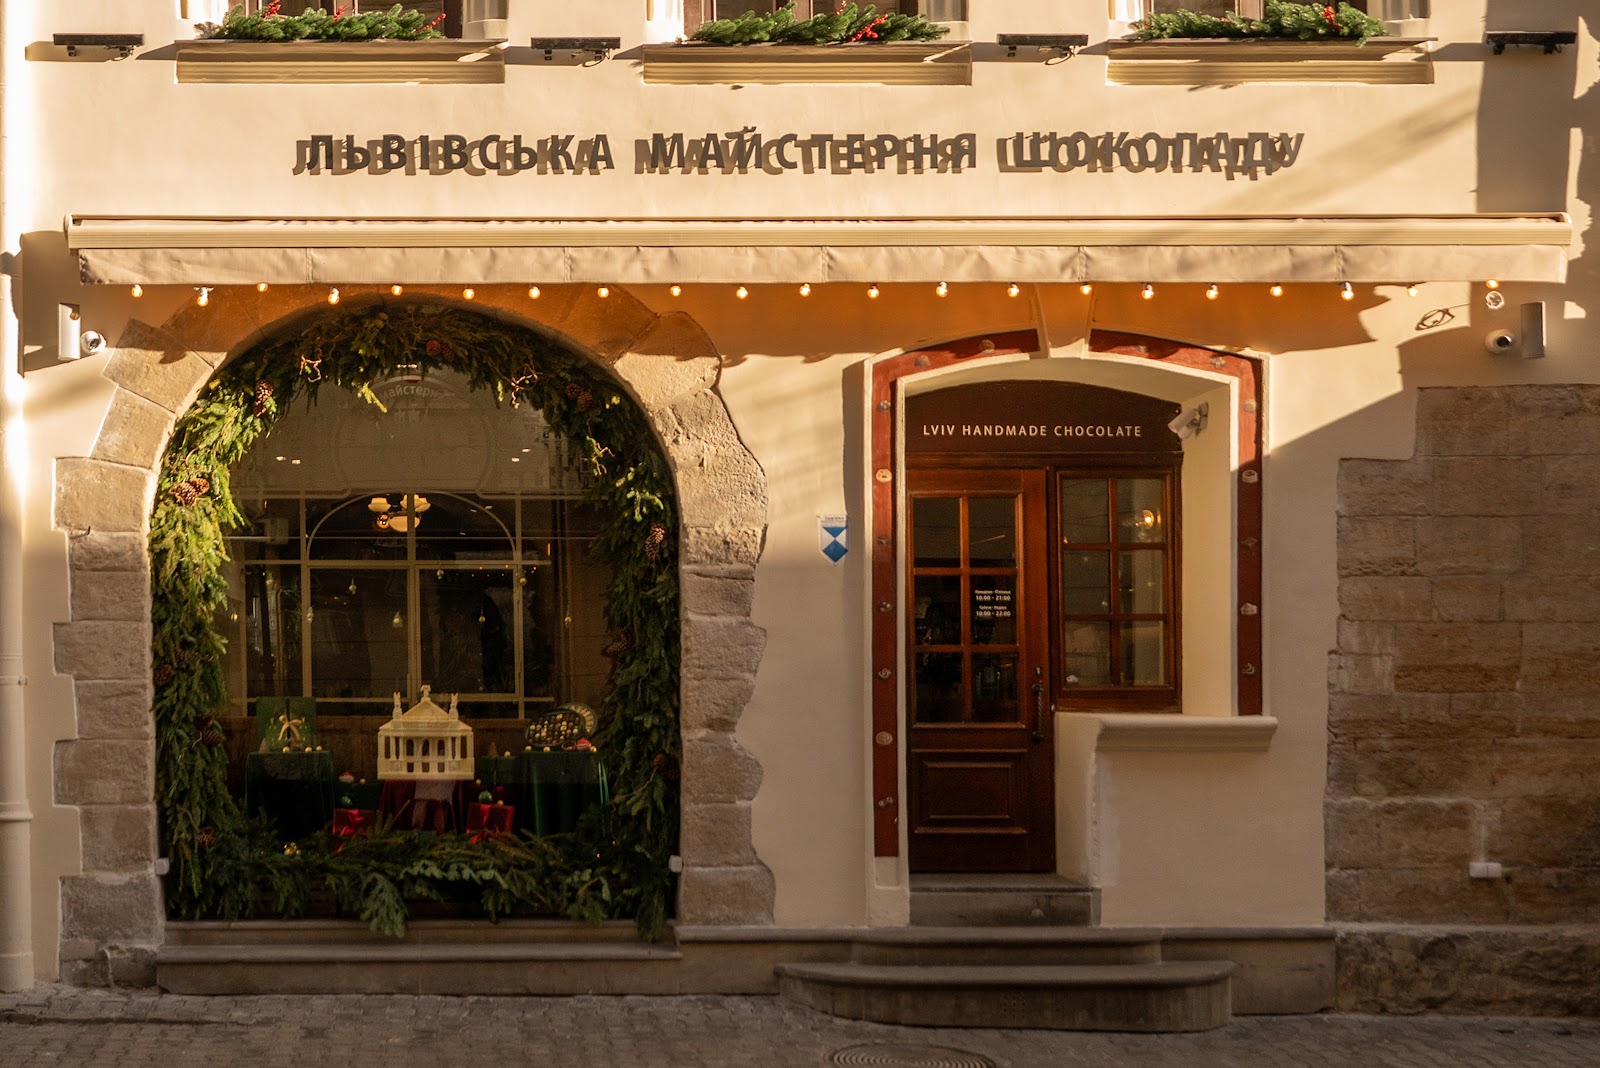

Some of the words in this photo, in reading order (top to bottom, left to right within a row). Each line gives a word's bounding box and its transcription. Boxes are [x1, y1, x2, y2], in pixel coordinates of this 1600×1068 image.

[306, 134, 615, 170] ЛЬВІВСЬКА
[650, 126, 976, 169] МАЙСТЕРНЯ
[1015, 131, 1305, 176] ШОКОЛАДУ
[922, 424, 955, 436] LVIV
[961, 424, 1047, 437] HANDMADE
[1053, 425, 1142, 438] CHOCOLATE
